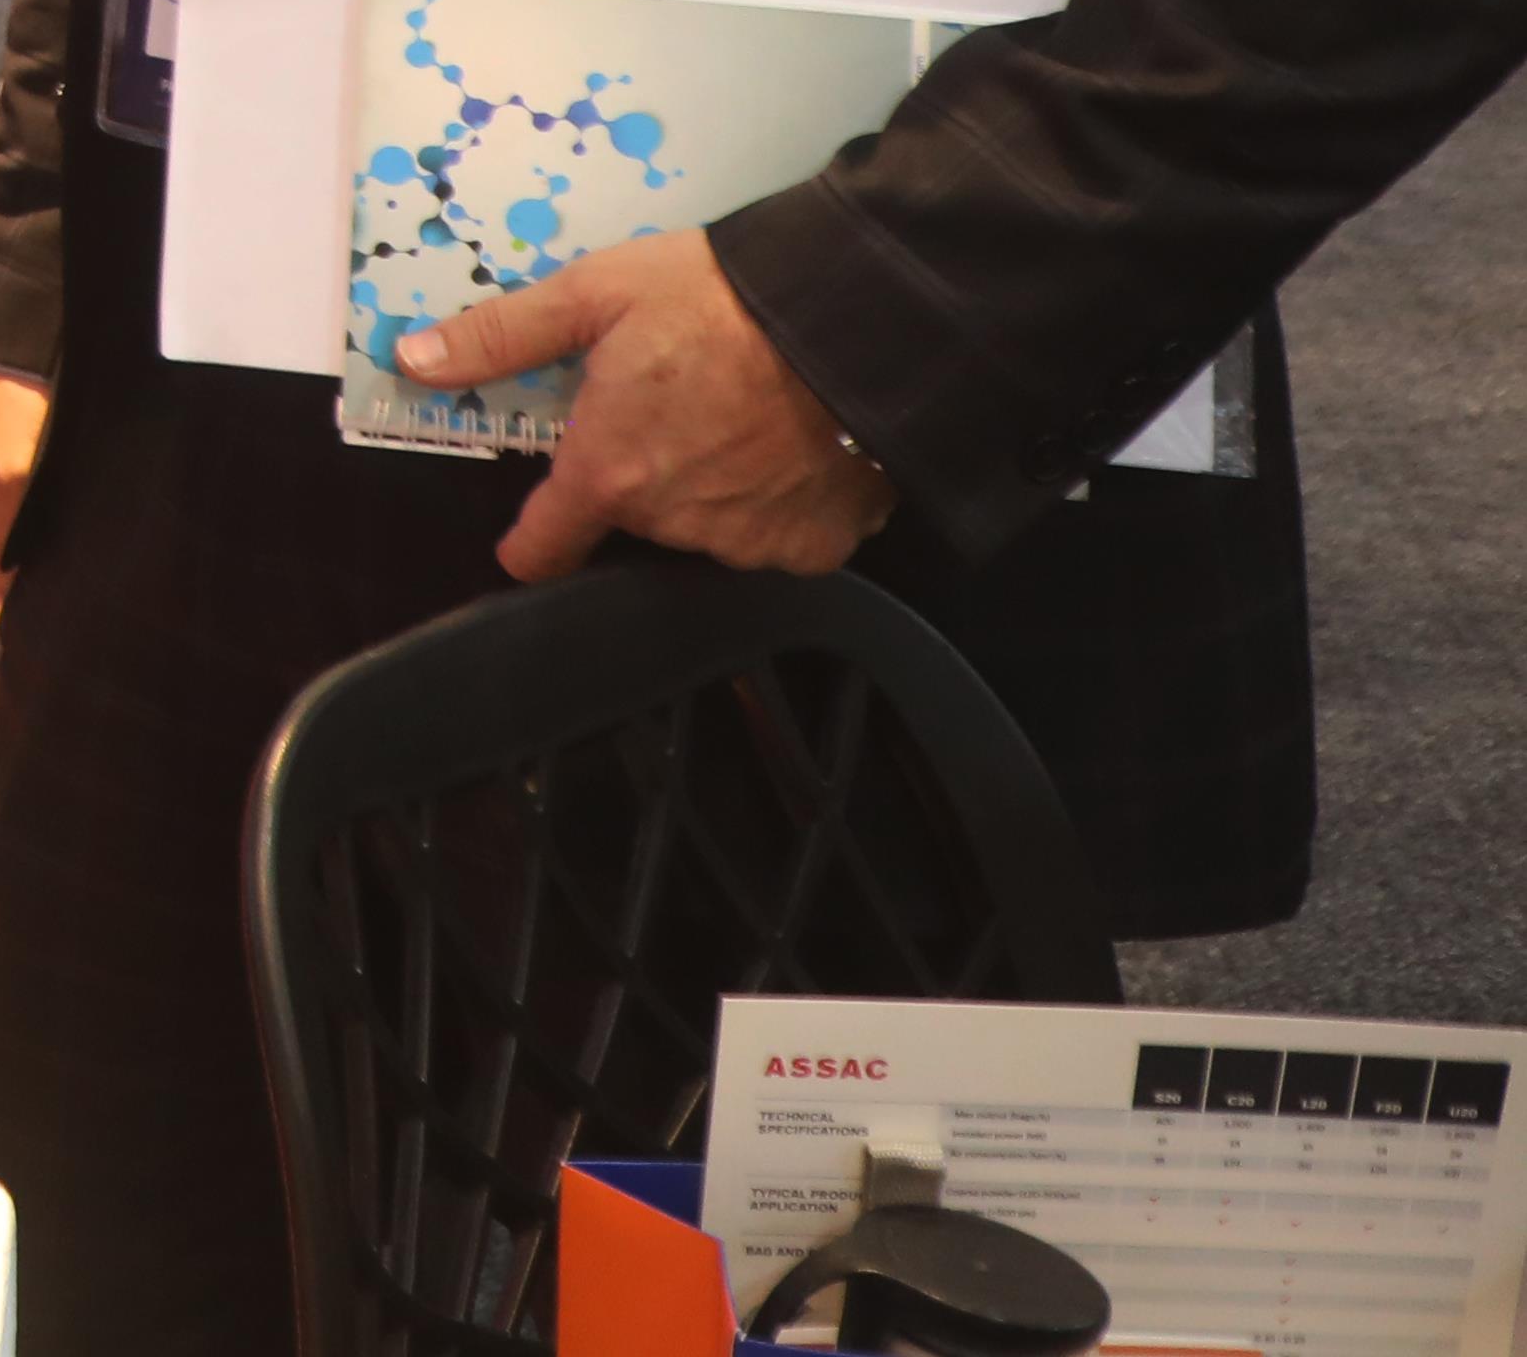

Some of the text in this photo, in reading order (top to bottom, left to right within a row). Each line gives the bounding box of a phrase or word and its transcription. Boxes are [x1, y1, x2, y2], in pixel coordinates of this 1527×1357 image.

[764, 1056, 890, 1081] ASSAC
[759, 1110, 836, 1123] TECHNICAL
[757, 1124, 869, 1138] SPECIFICATIONS
[750, 1188, 864, 1202] TYPICAL PRODU
[749, 1201, 839, 1214] APPLICATION
[745, 1246, 773, 1257] BAG
[777, 1247, 805, 1258] AND
